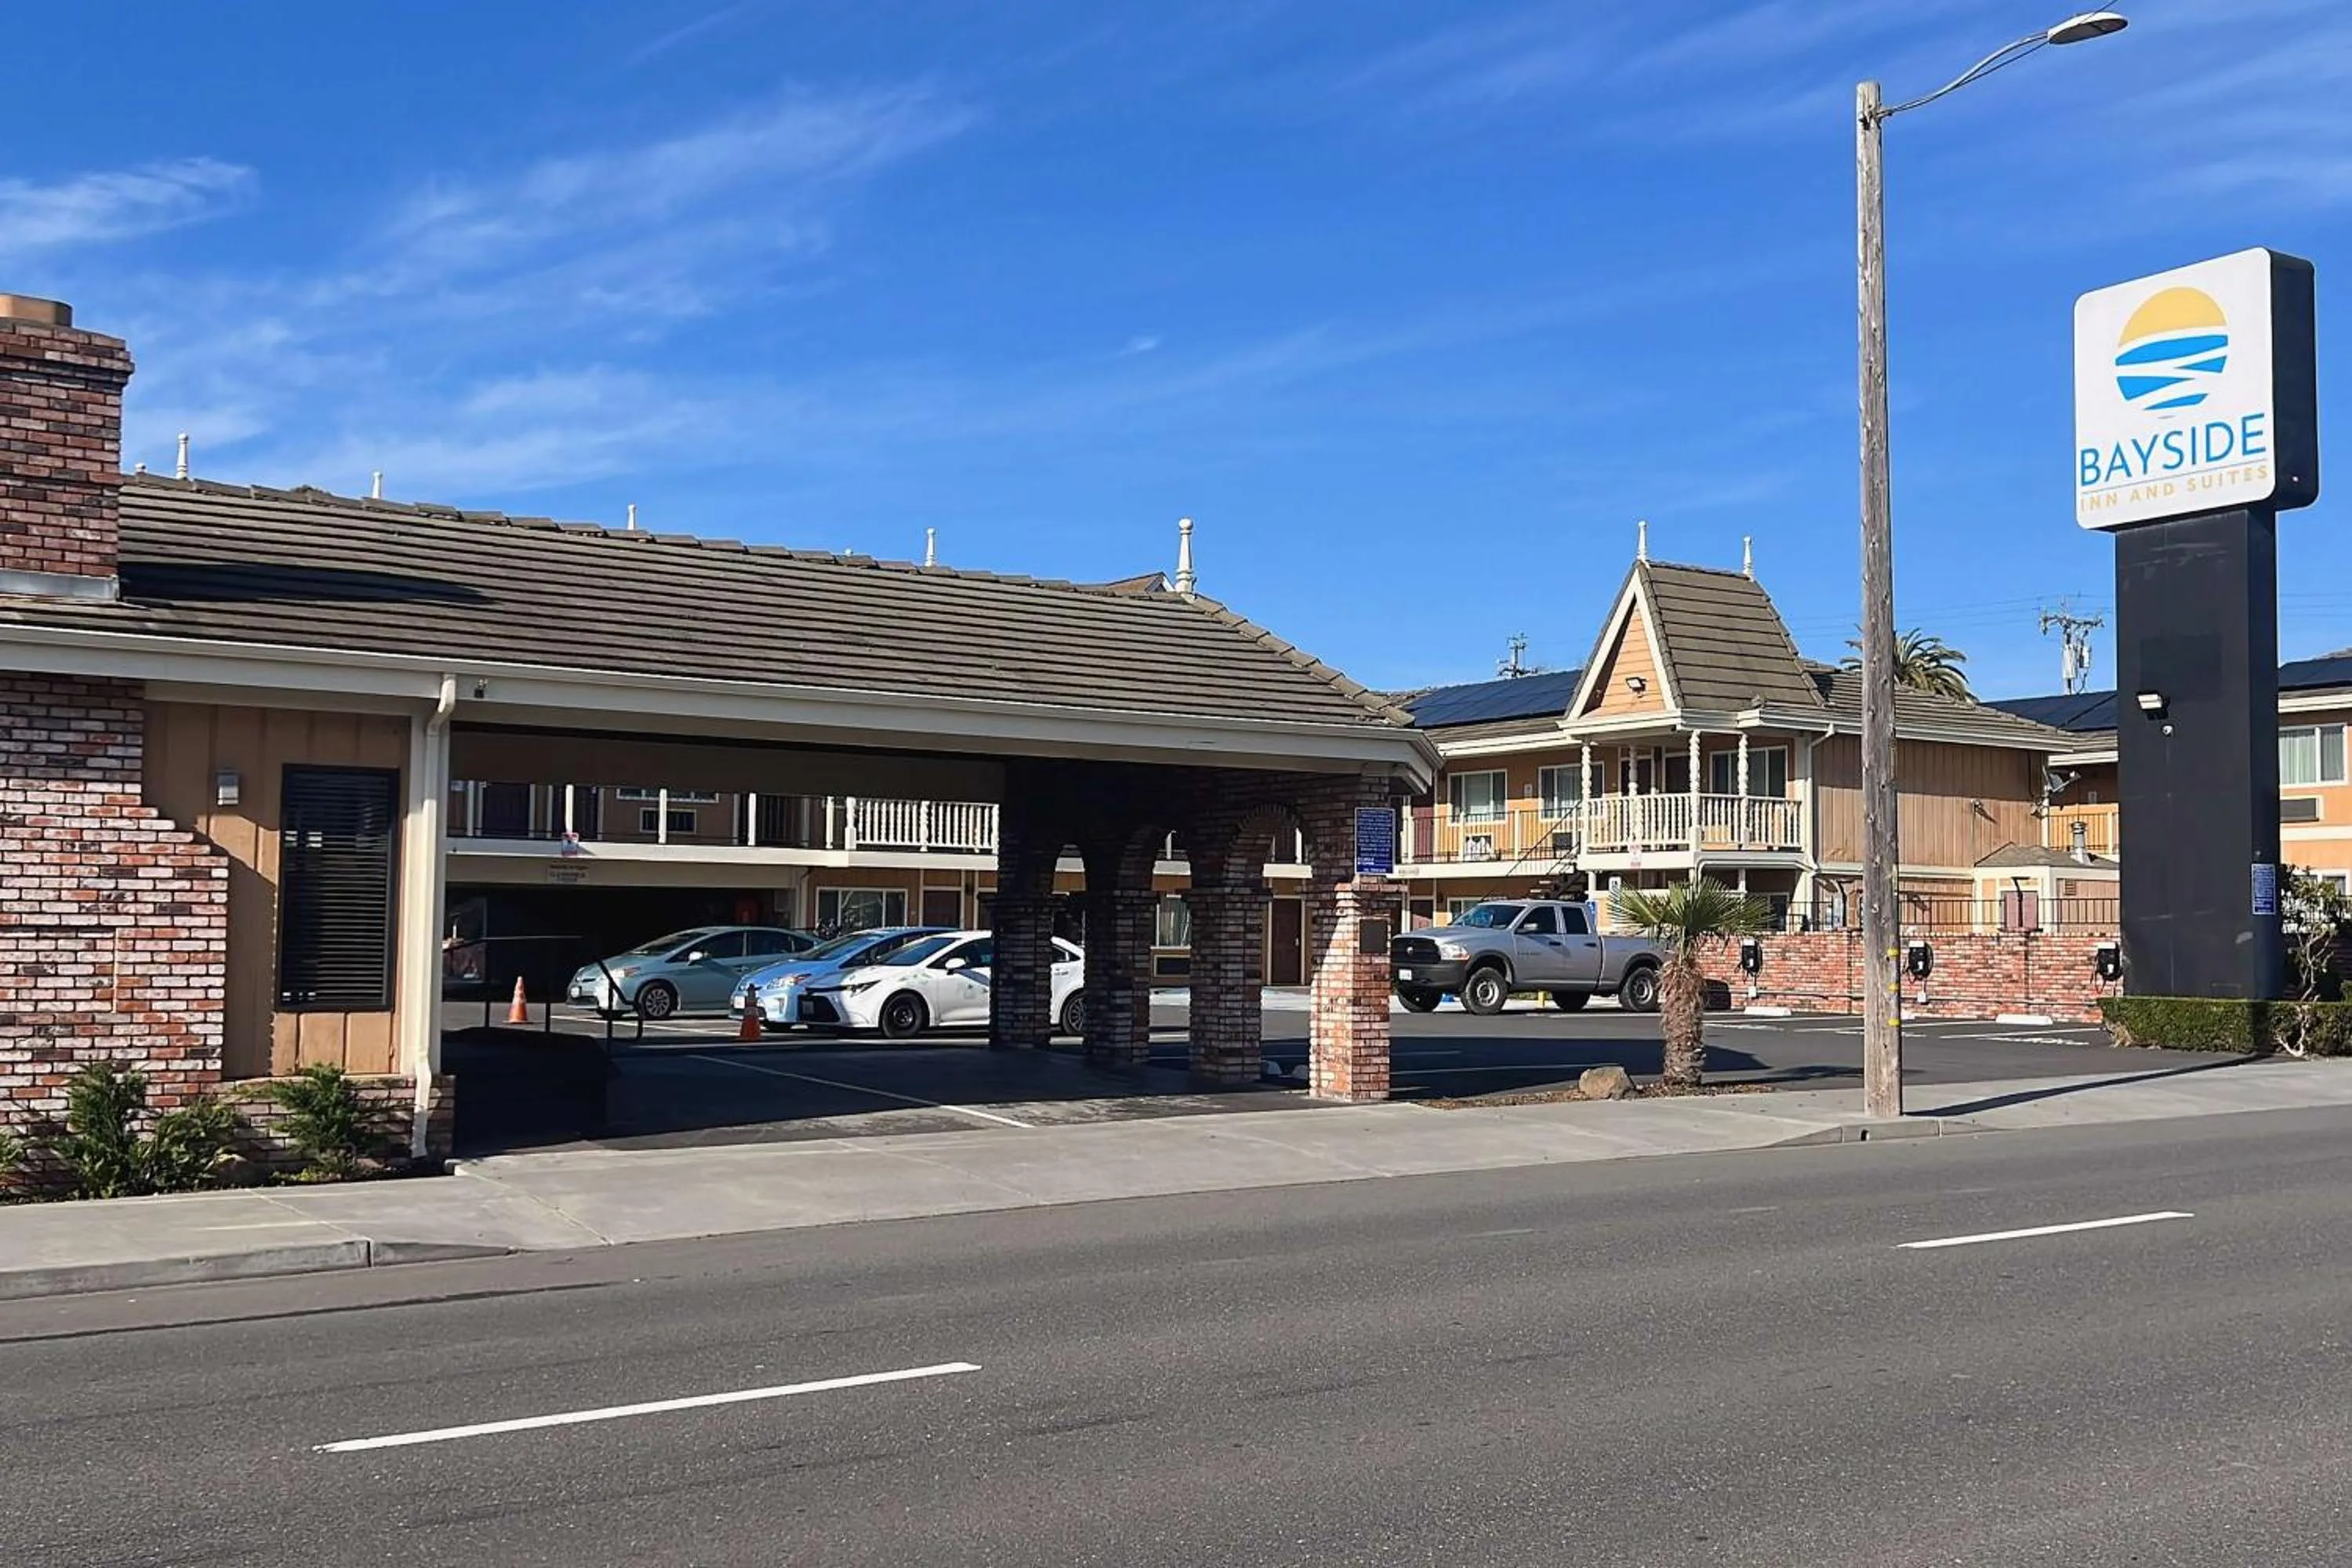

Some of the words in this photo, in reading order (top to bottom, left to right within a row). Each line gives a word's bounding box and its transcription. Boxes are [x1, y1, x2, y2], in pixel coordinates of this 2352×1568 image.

[2080, 412, 2267, 487] BAYSIDE
[2080, 493, 2118, 511] INN
[2130, 483, 2175, 503] AND
[2187, 466, 2268, 492] SUITES
